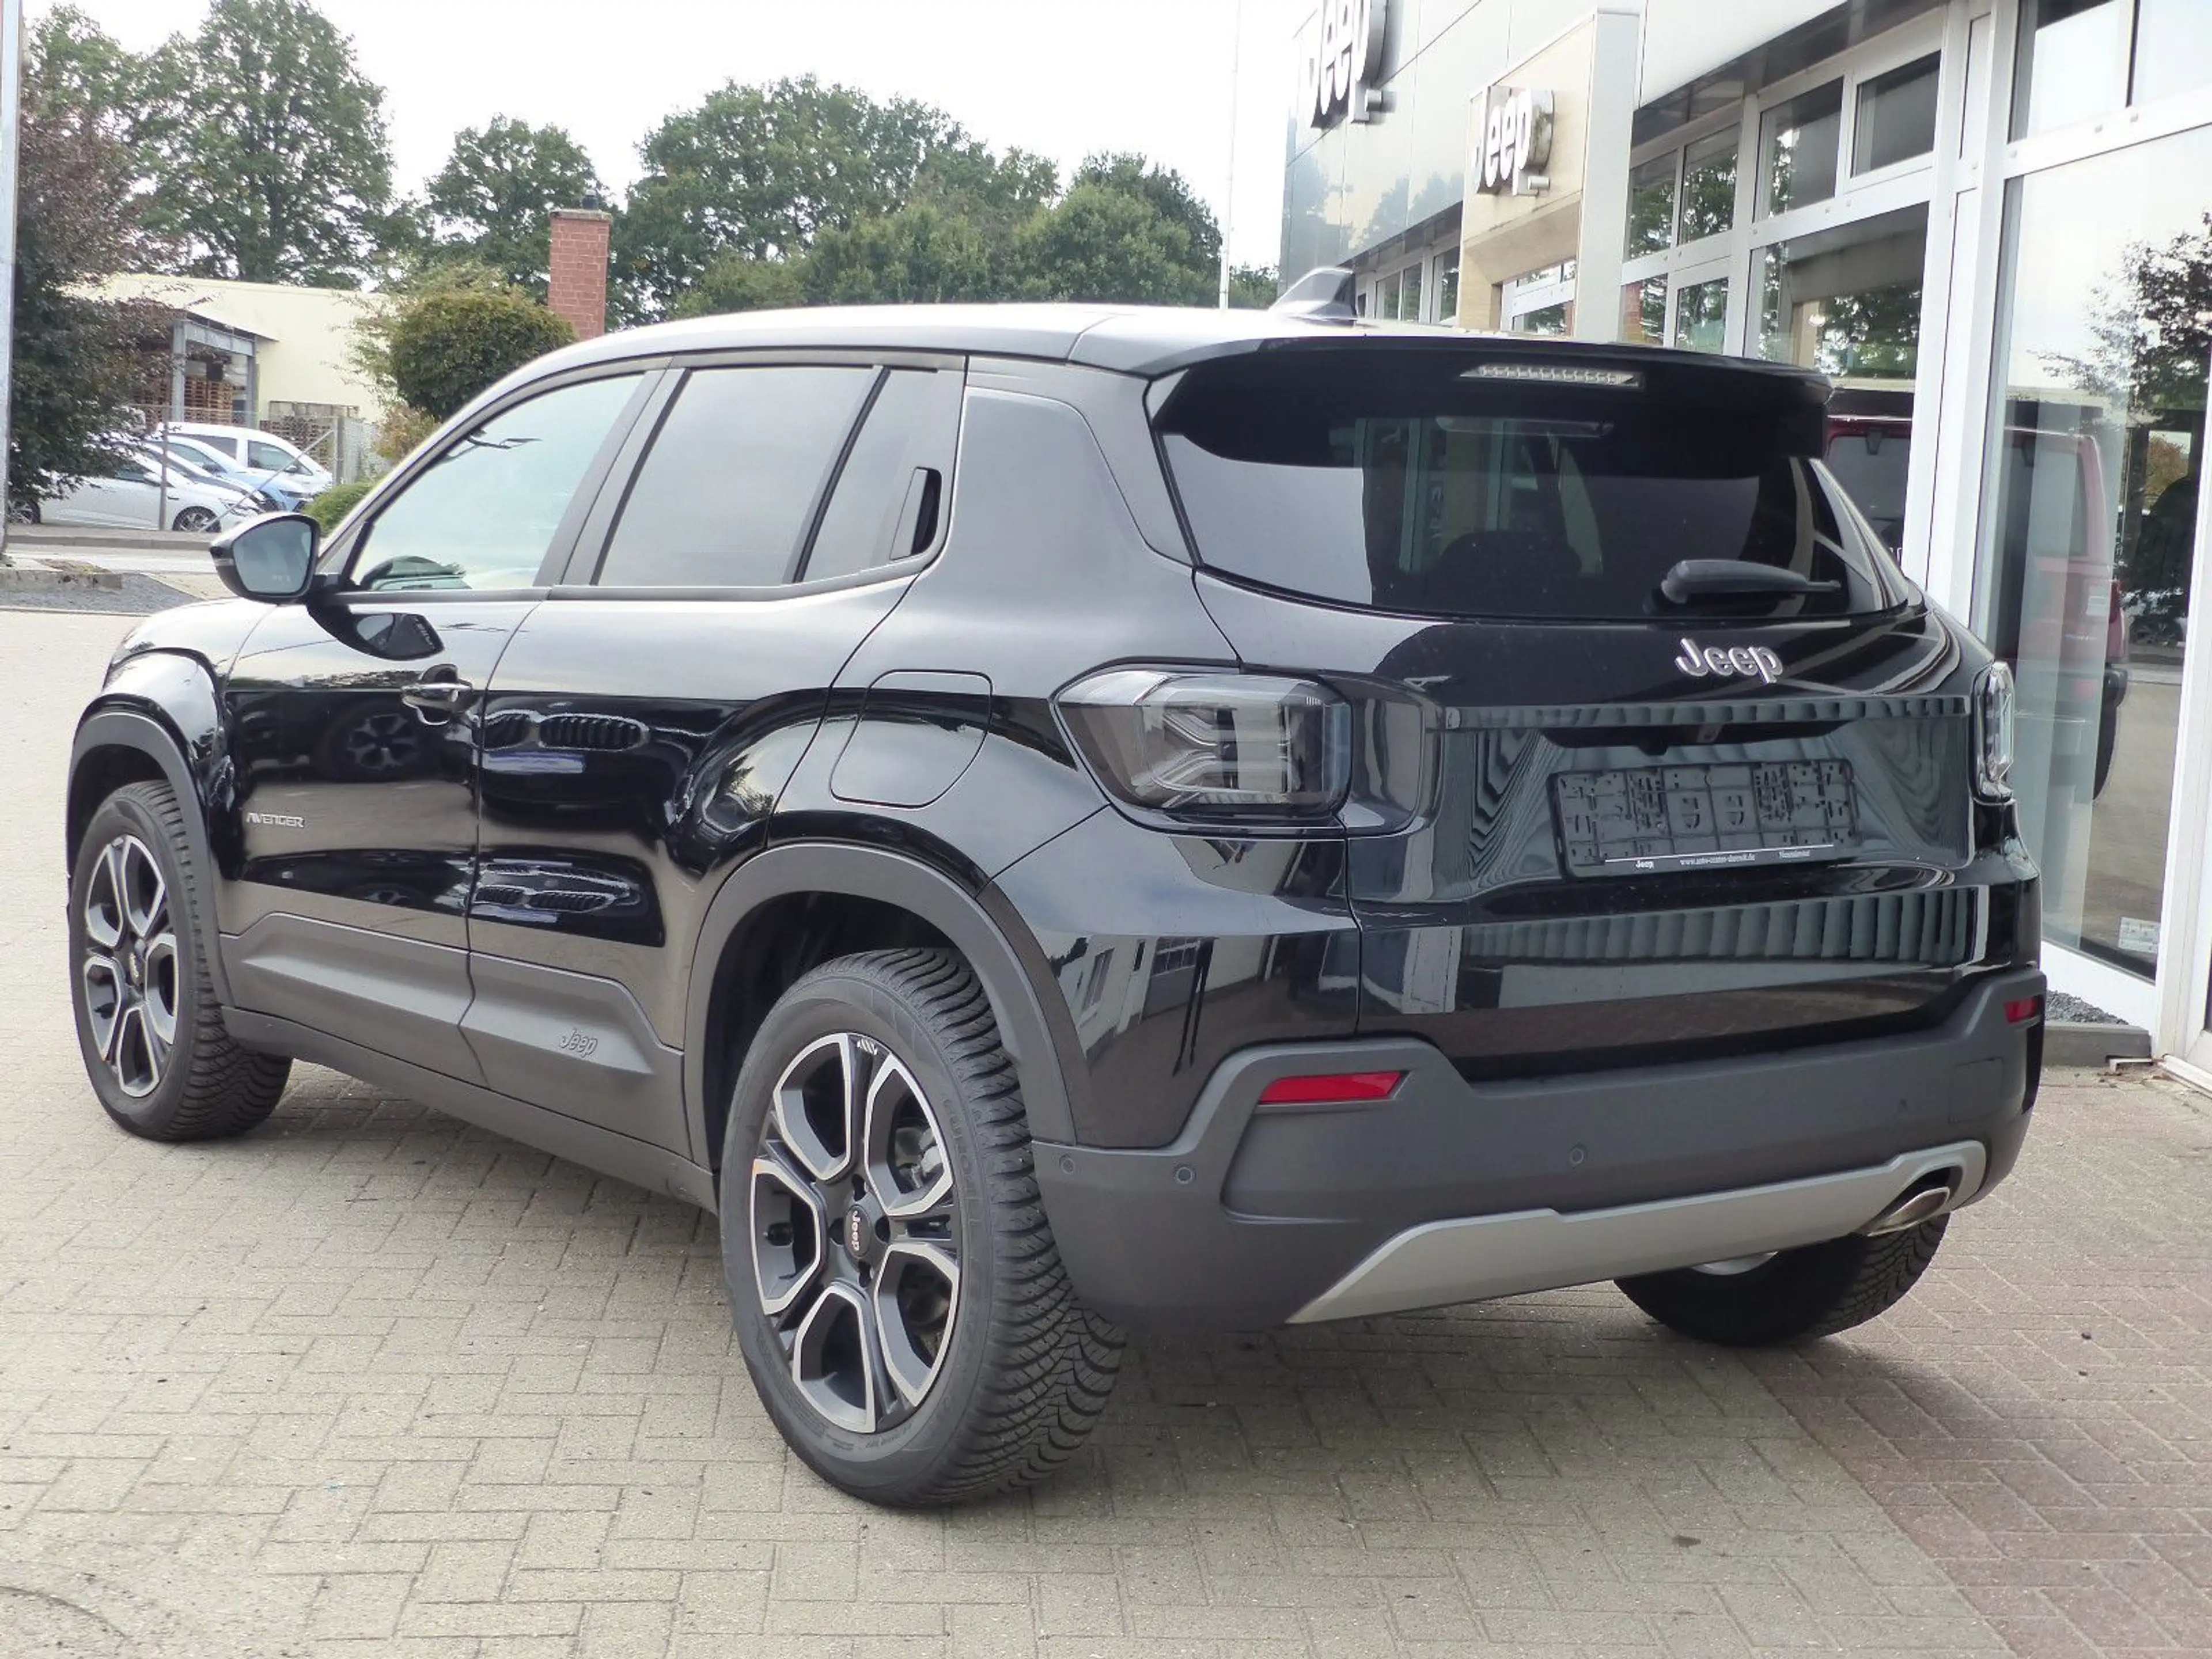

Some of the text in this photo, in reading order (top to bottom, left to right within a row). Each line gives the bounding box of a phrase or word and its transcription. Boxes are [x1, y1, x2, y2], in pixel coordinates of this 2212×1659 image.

[1675, 638, 1783, 684] Jeep
[246, 812, 304, 828] AVENGER
[559, 1027, 598, 1058] Jeep
[851, 1210, 861, 1251] Jeep
